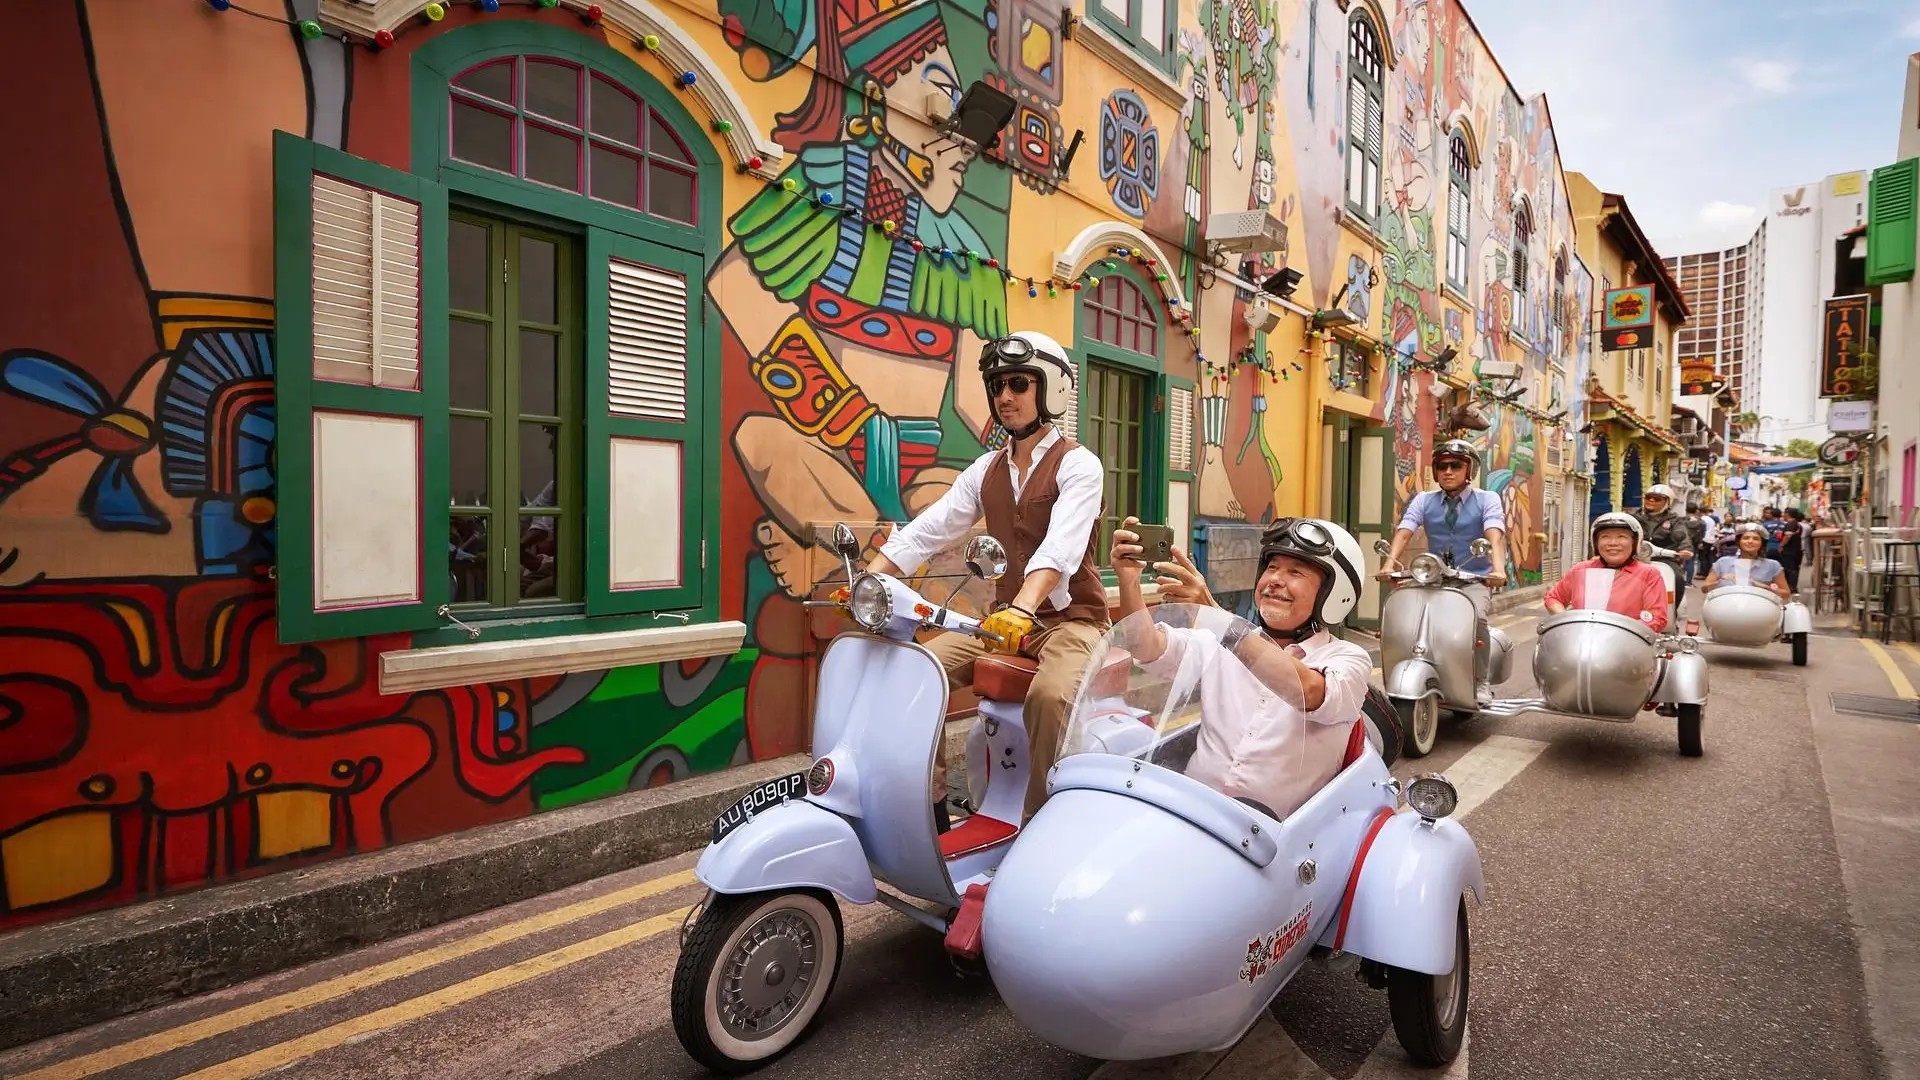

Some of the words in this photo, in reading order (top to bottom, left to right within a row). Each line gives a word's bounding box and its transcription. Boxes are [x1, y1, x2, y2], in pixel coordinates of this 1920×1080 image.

[1833, 307, 1853, 395] TATTOO
[718, 774, 801, 834] AU8090P
[1275, 900, 1313, 940] SINGAPORE
